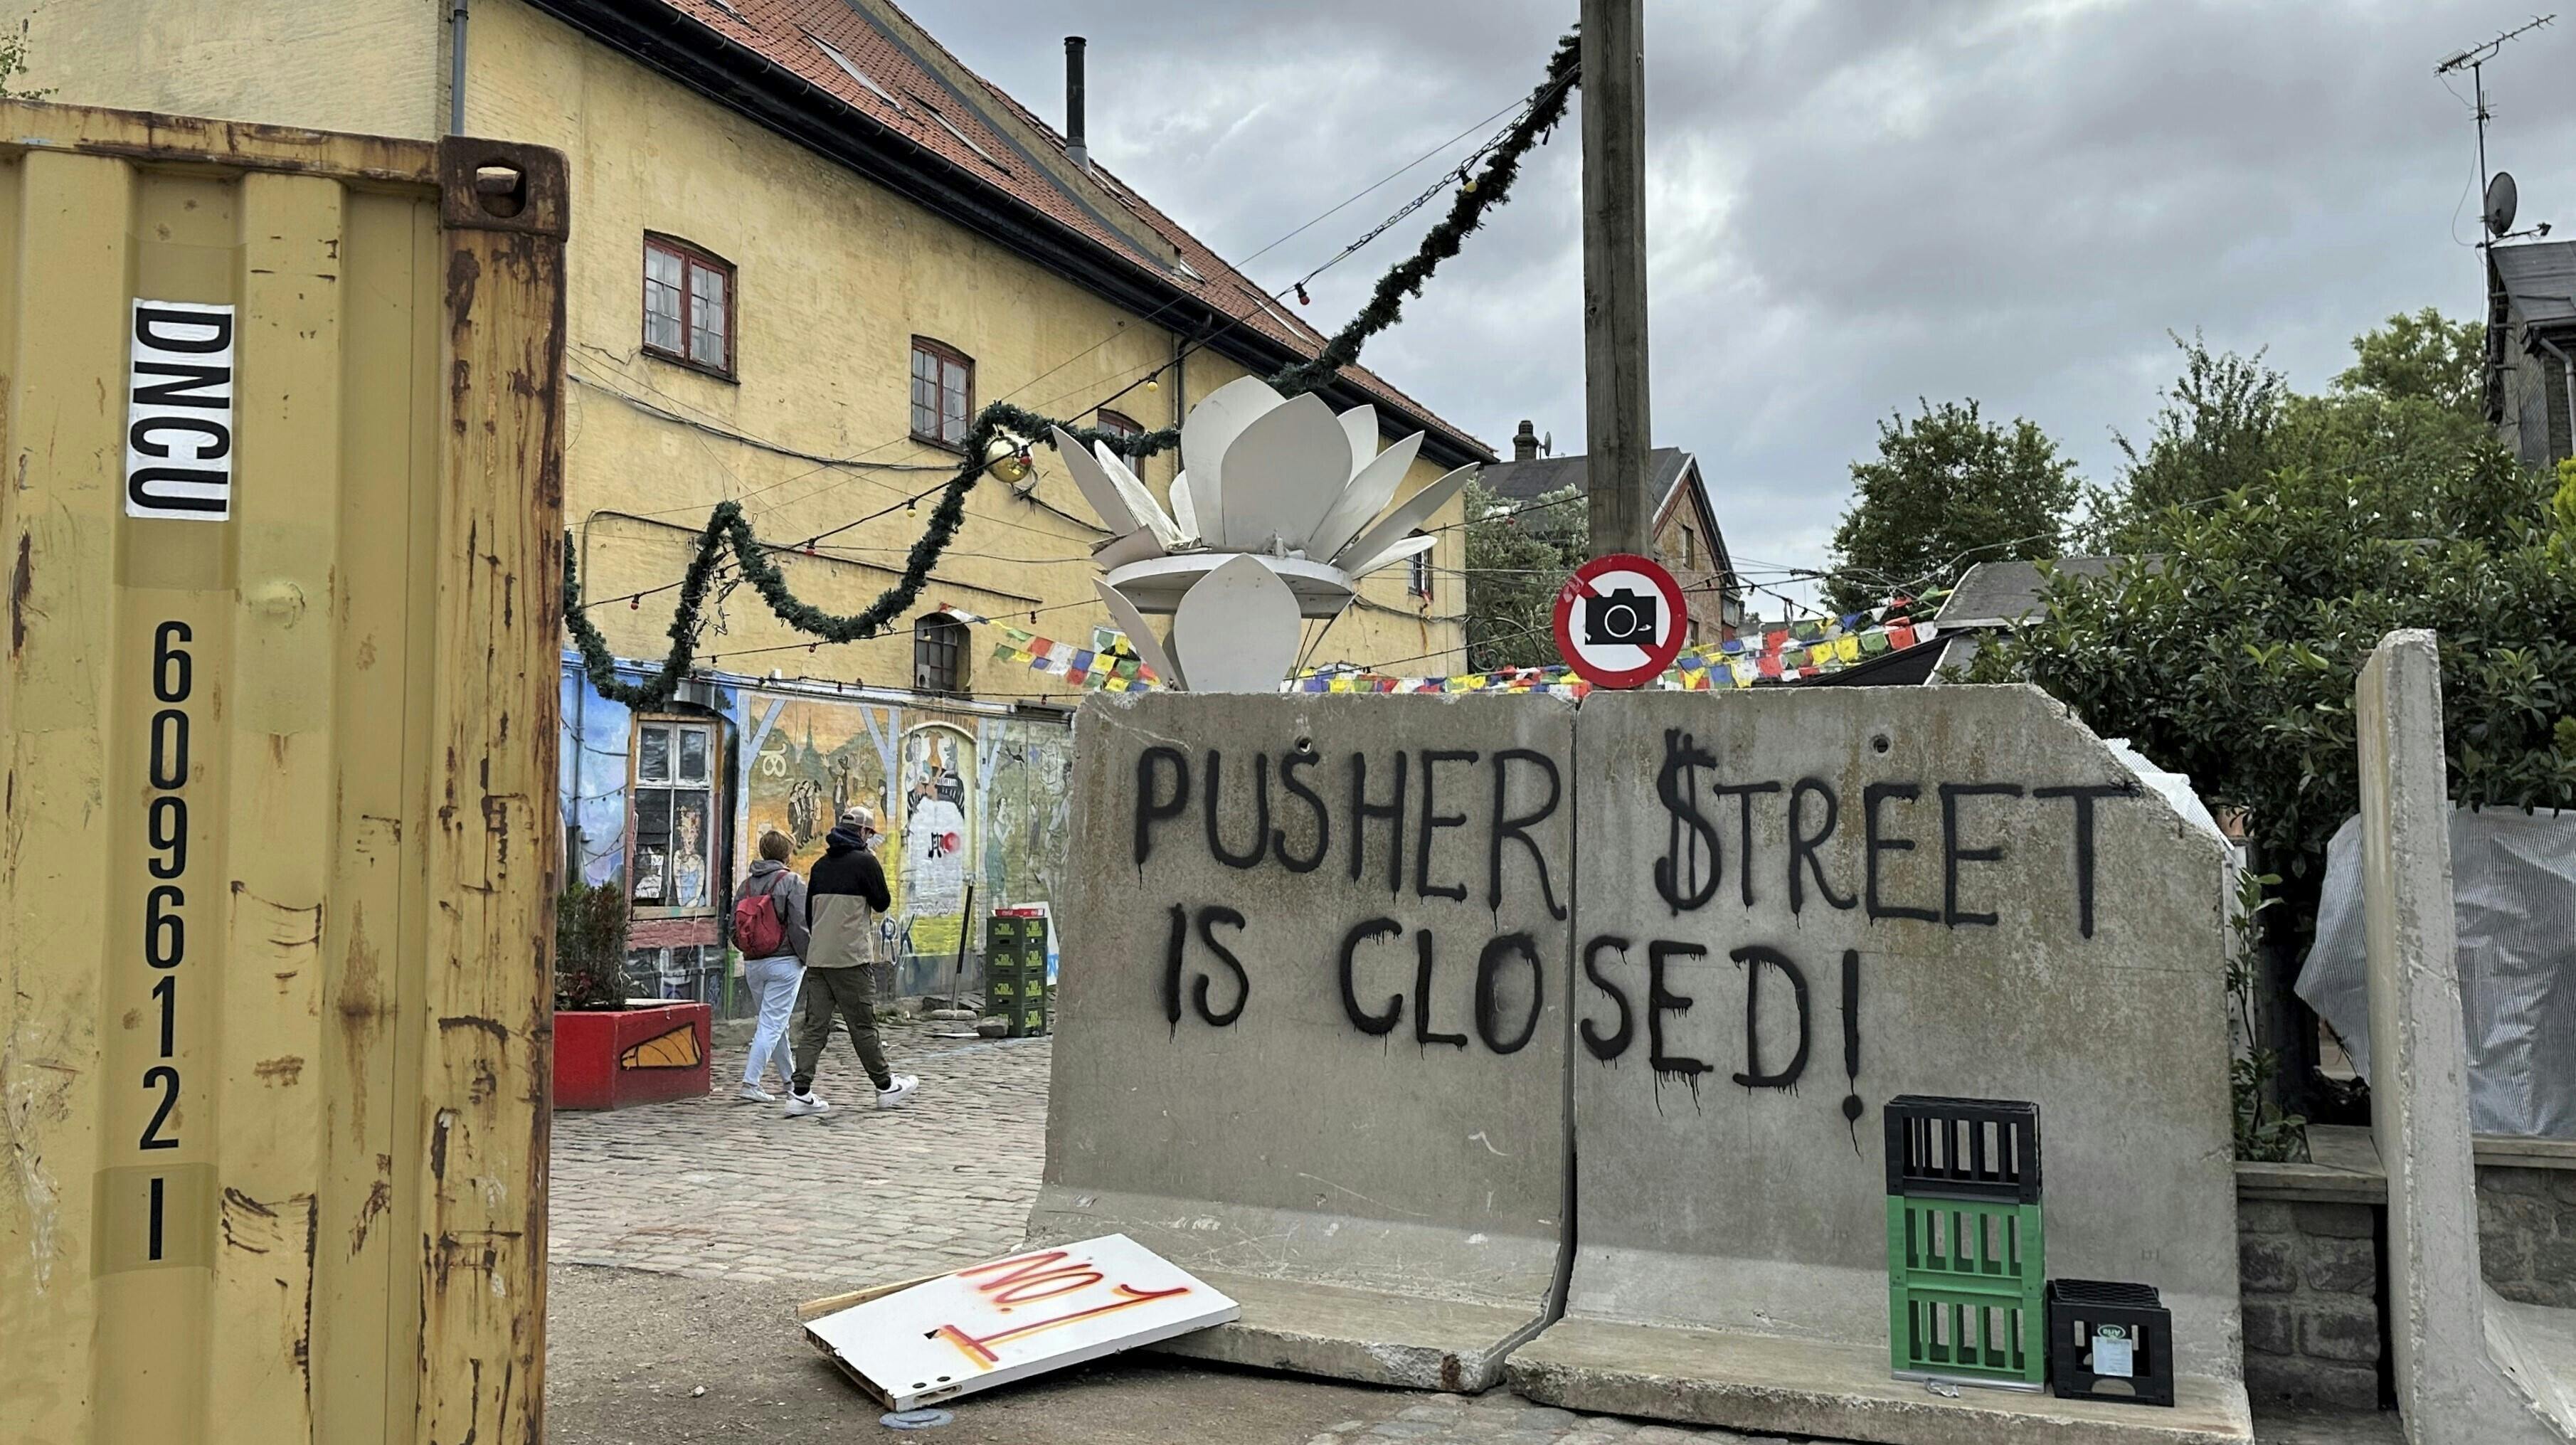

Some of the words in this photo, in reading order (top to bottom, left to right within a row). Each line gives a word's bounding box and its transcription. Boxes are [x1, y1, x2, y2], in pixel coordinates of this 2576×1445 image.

[129, 307, 233, 513] DNCU
[1135, 746, 1567, 928] PUSHER
[1164, 902, 1250, 1037] IS
[1339, 916, 1861, 1124] CLOSED!
